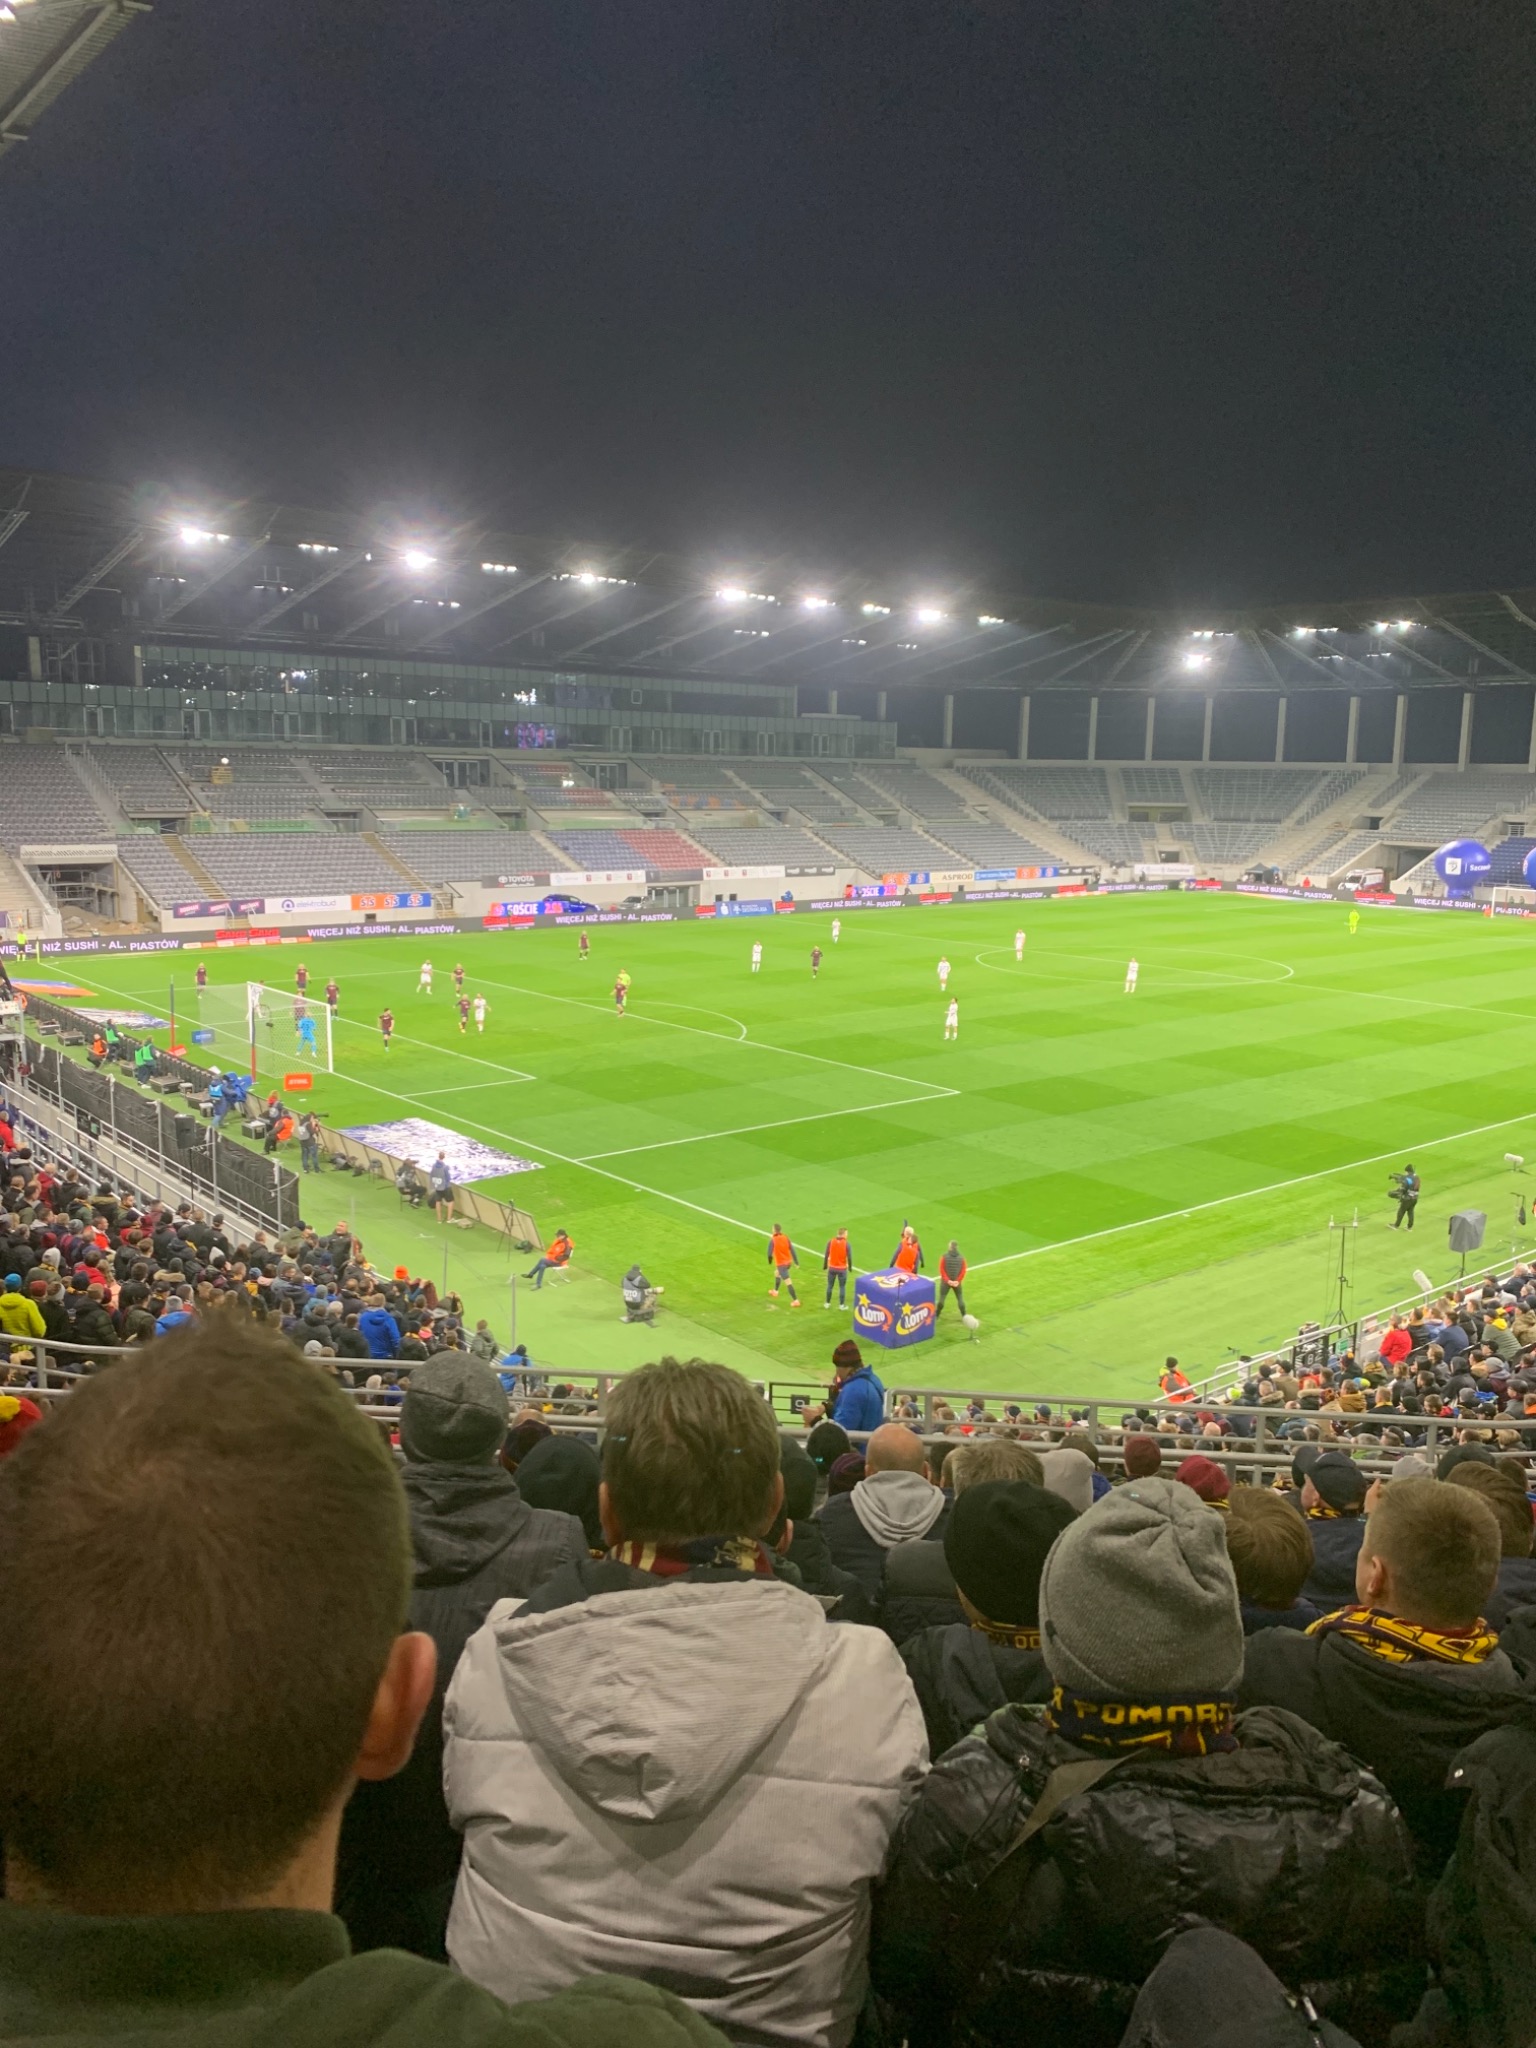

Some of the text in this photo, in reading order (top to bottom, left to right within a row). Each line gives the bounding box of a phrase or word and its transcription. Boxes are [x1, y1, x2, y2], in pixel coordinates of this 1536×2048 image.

[509, 875, 535, 883] TOYOTA
[942, 873, 973, 881] ASPROD
[1454, 900, 1476, 909] SUSHI
[555, 915, 583, 925] WIĘCEJ
[600, 913, 622, 921] SUSHI
[641, 912, 673, 922] PIASTÓW
[307, 928, 344, 938] WIĘCEJ
[346, 926, 361, 935] NIŻ
[363, 925, 391, 934] SUSHI
[415, 924, 455, 935] PIASTÓW
[42, 941, 62, 952] NIŻ
[64, 940, 99, 951] SUSHI
[130, 938, 179, 951] PIASTÓW
[861, 1306, 886, 1323] LOTTO
[904, 1307, 929, 1329] LOTTO
